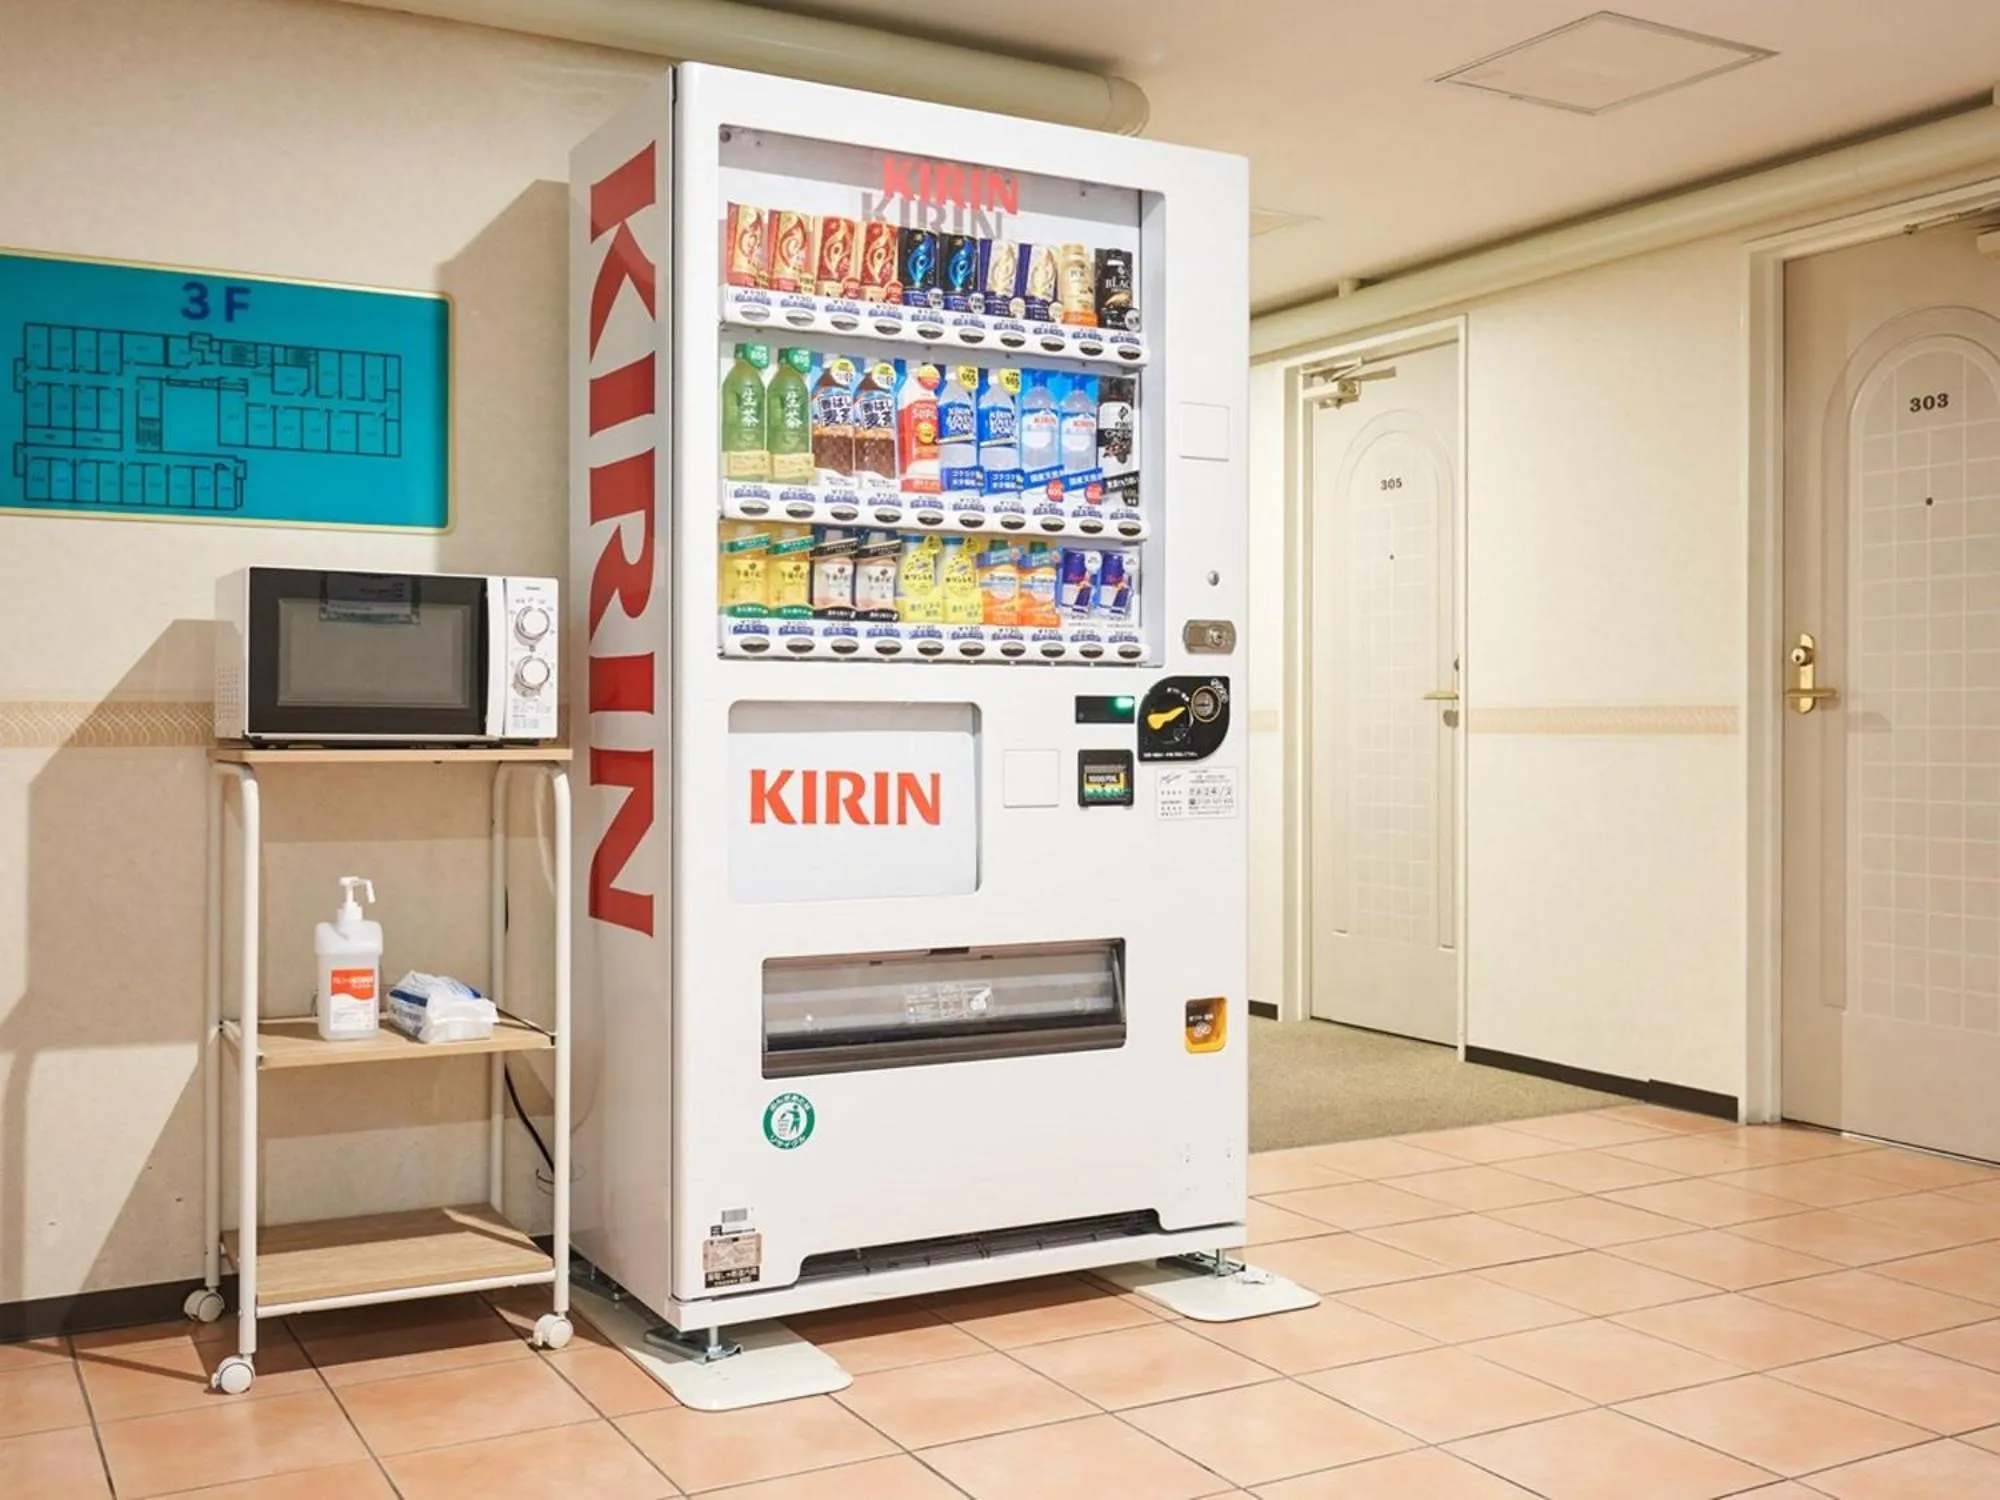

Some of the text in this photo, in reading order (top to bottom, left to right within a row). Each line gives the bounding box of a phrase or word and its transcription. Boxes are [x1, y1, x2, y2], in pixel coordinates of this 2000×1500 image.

[883, 155, 1019, 215] KIRIN
[1909, 392, 1949, 413] 303
[1380, 477, 1402, 490] 305
[589, 148, 655, 936] KIRIN
[751, 769, 940, 826] KIRIN
